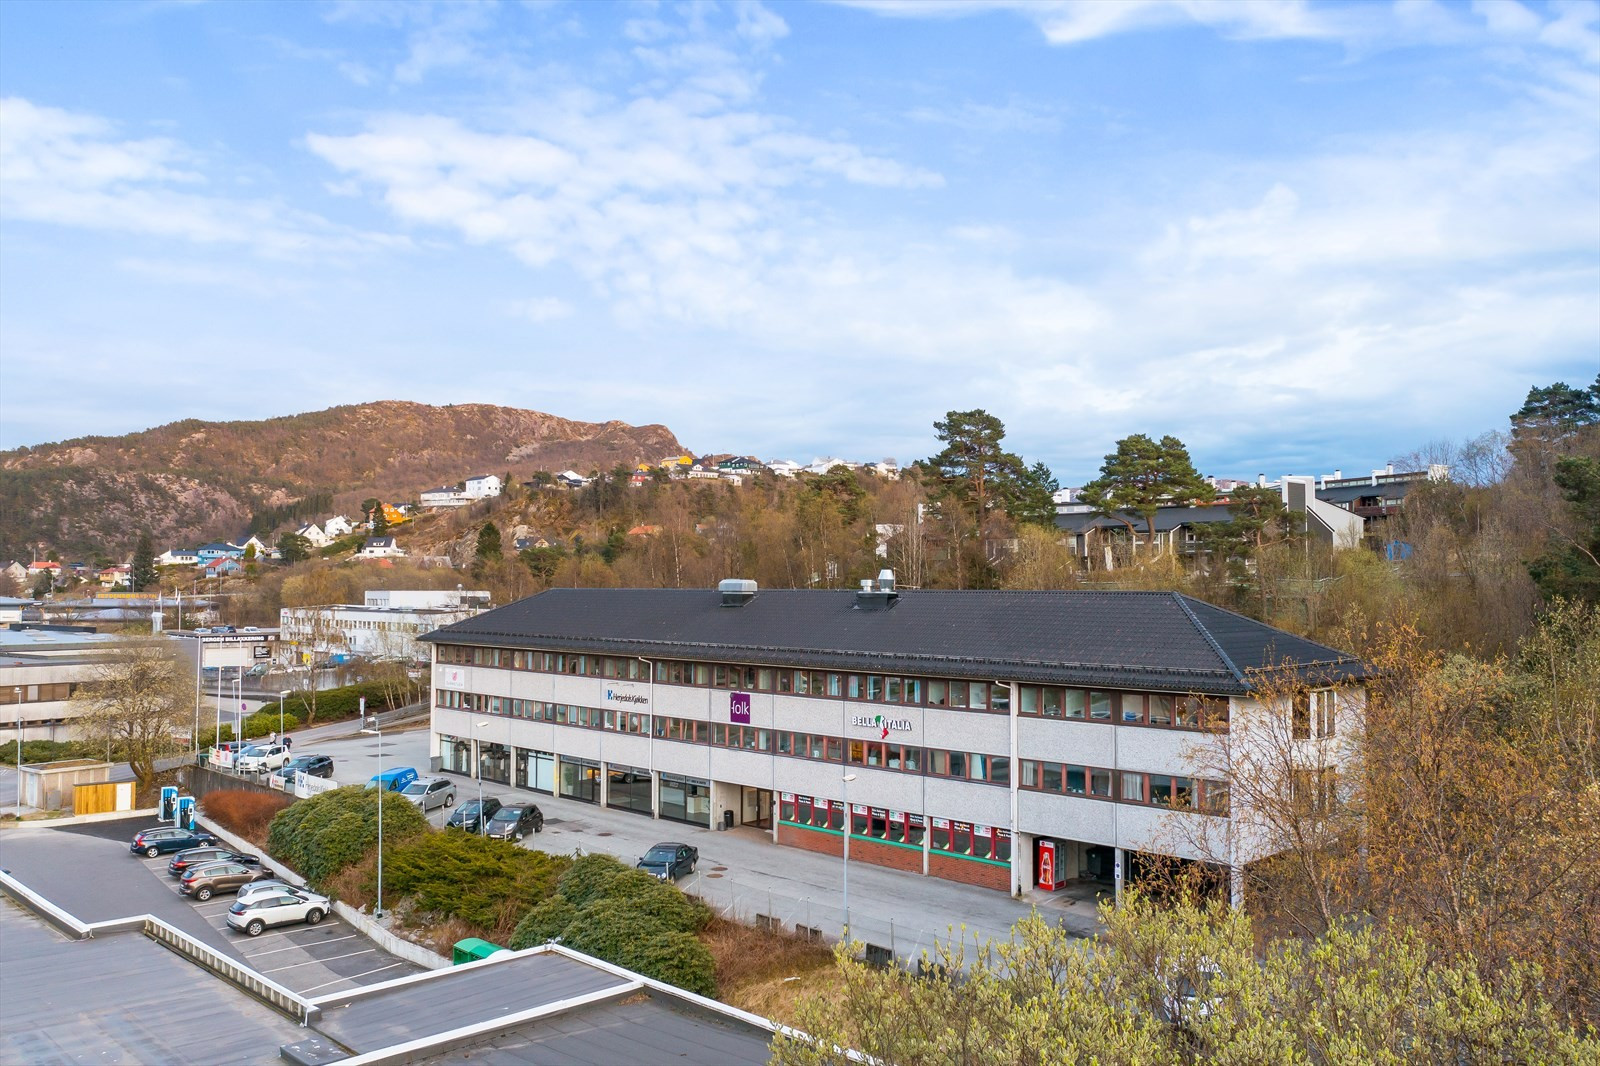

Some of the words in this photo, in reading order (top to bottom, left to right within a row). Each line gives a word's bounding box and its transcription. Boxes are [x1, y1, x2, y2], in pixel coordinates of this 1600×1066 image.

[731, 700, 749, 715] folk
[852, 716, 877, 727] BELLA
[884, 719, 912, 731] ITALIA
